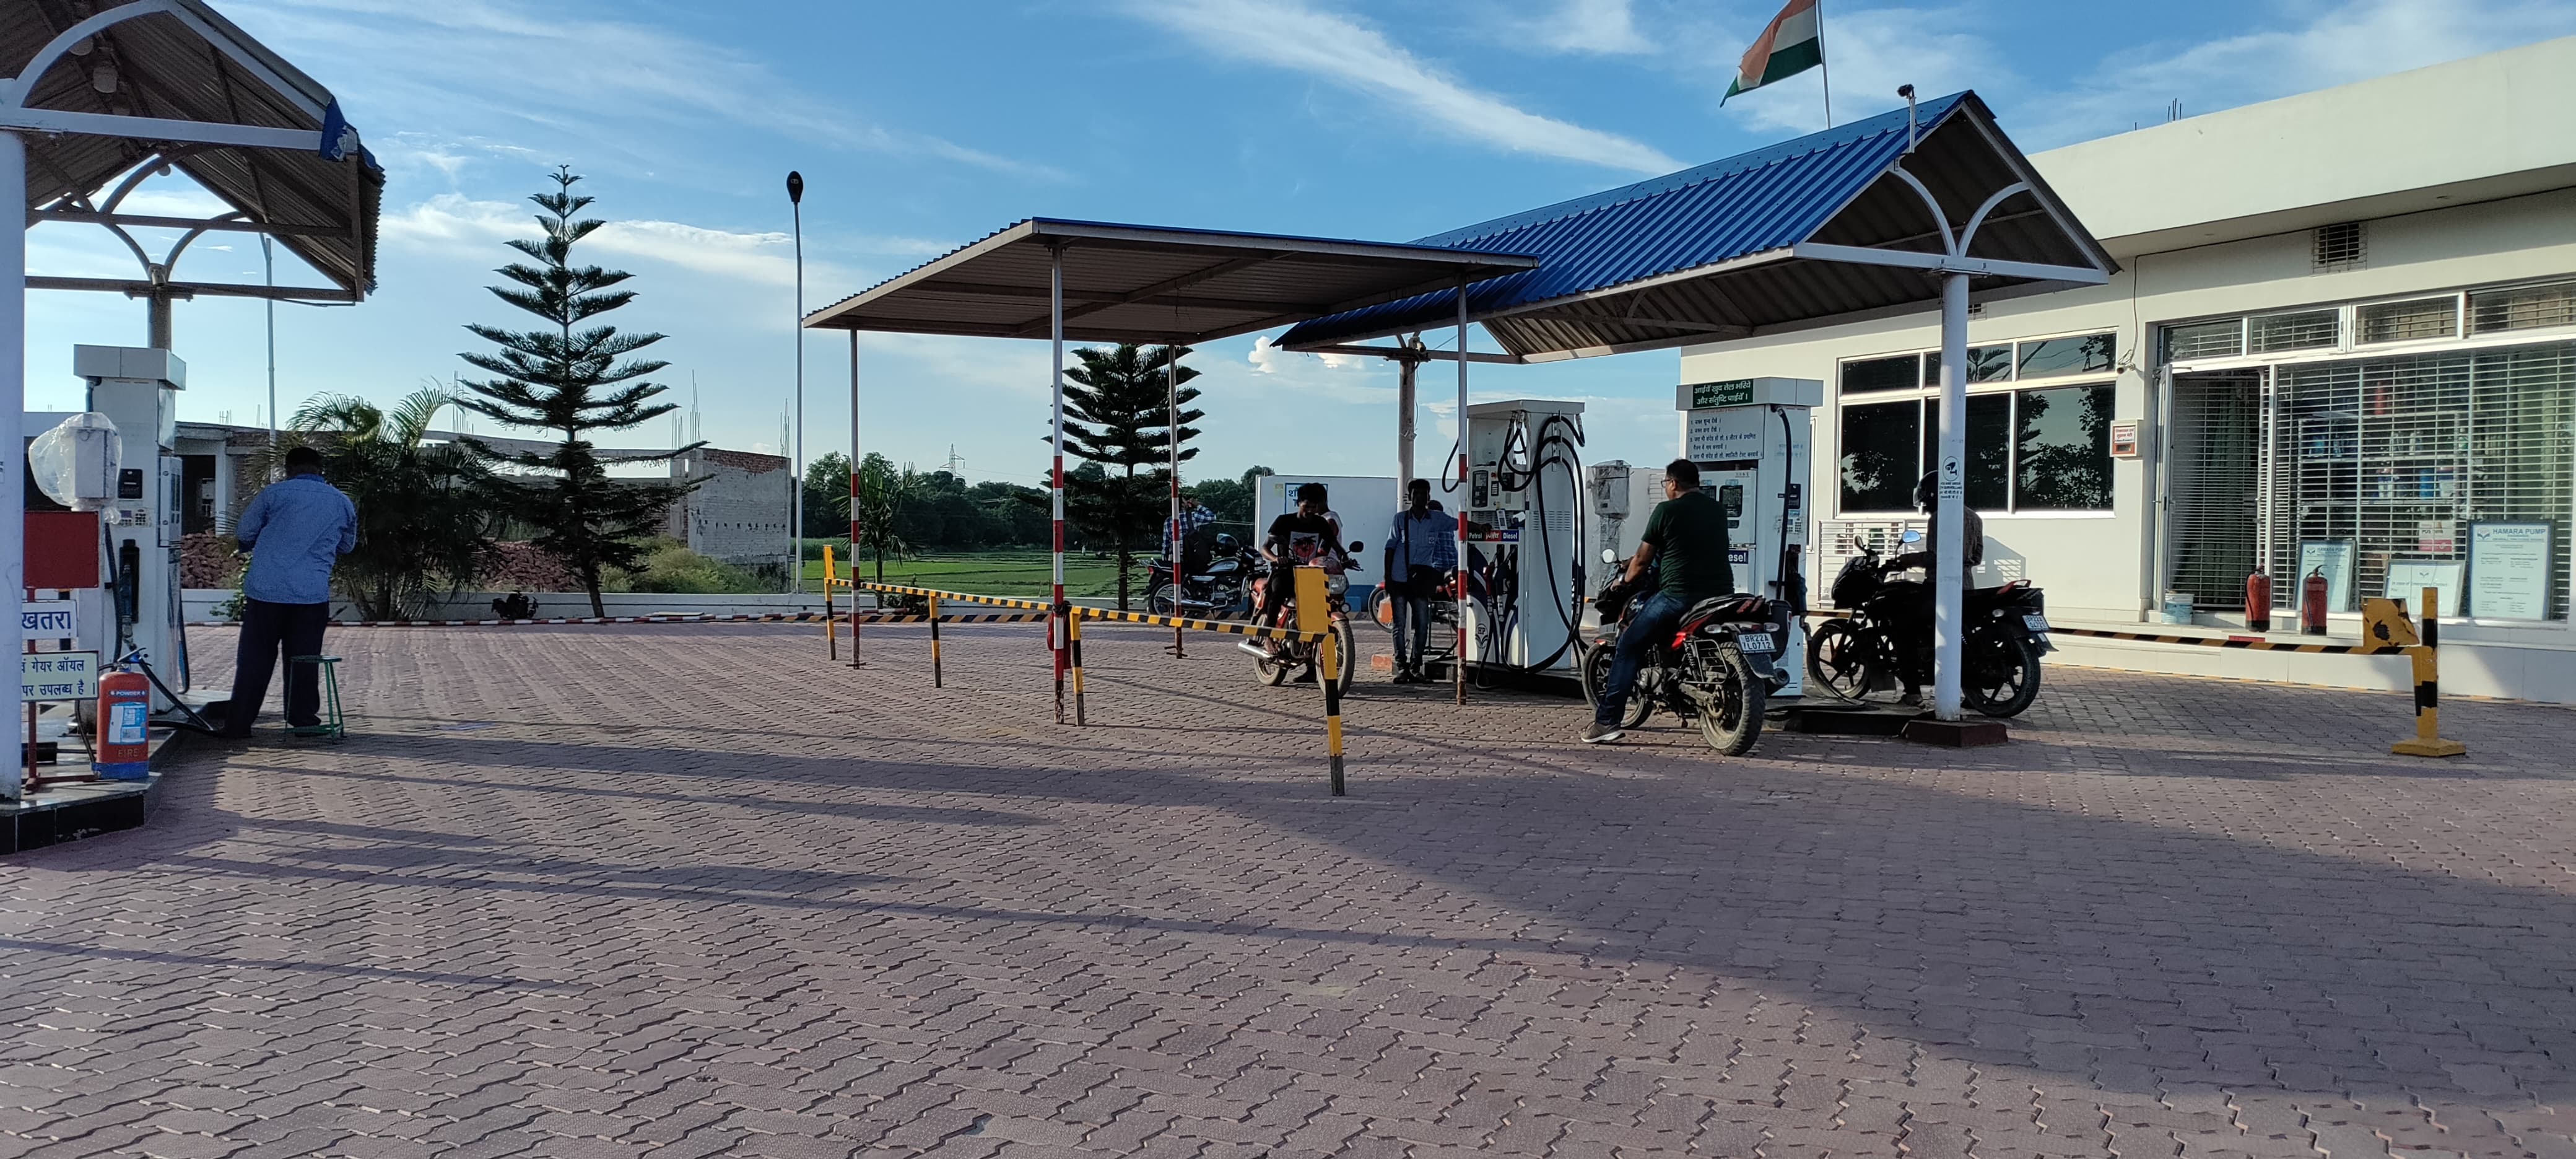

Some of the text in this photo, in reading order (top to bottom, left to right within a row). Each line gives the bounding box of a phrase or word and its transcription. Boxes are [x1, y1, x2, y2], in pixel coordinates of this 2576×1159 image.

[1712, 385, 1723, 394] खुद
[1697, 396, 1708, 405] और
[1728, 552, 1746, 562] esel
[22, 611, 71, 630] खतरा
[31, 657, 53, 673] गेयर
[57, 657, 85, 673] ऑयल
[38, 683, 73, 695] उपलब्ध
[77, 680, 85, 694] है
